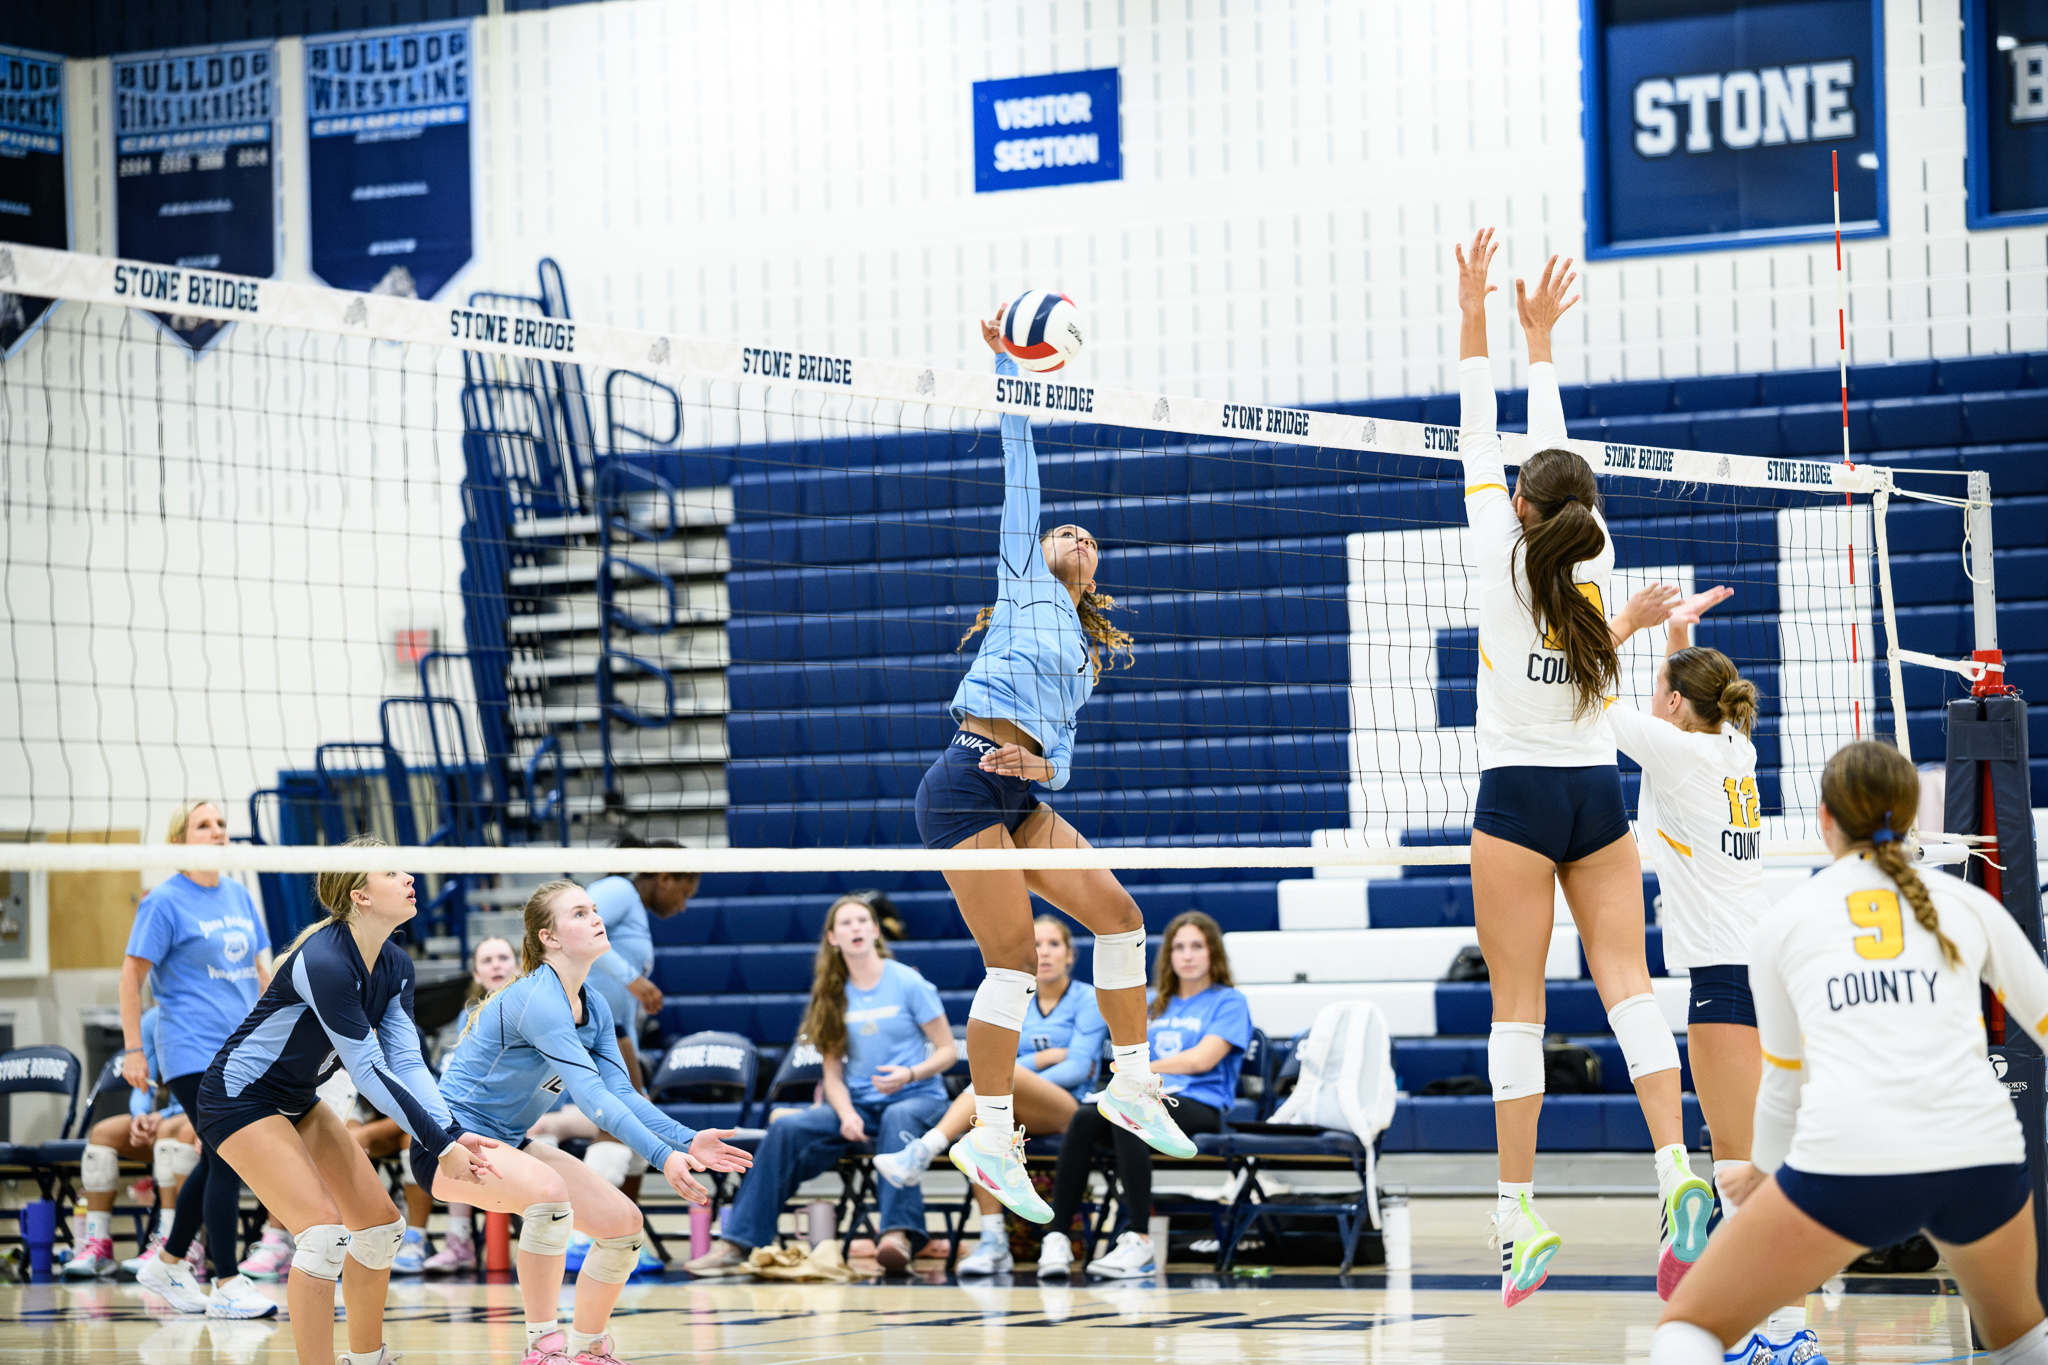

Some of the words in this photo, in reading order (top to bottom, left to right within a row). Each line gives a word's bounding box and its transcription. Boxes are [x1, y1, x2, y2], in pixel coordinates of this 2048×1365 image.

[119, 54, 268, 92] BULLDOG
[312, 34, 465, 73] BULLDOG
[993, 92, 1093, 131] VISITOR
[1634, 59, 1856, 157] STONE
[993, 132, 1100, 172] SECTION
[114, 264, 181, 302] STONE
[188, 274, 259, 313] BRIDGE
[450, 309, 507, 344] STONE
[513, 317, 576, 353] BRIDGE
[743, 347, 792, 379] STONE
[799, 354, 852, 386] BRIDGE
[996, 378, 1042, 408] STONE
[1046, 383, 1095, 413] BRIDGE
[1221, 404, 1264, 431] STONE
[1266, 408, 1310, 437] BRIDGE
[1423, 426, 1460, 452] STONE
[1604, 444, 1636, 469] STONE
[1638, 448, 1675, 473] BRIDGE
[1767, 460, 1798, 483] STONE
[1799, 462, 1833, 485] BRIDGE
[1722, 776, 1761, 828] 12
[1721, 829, 1761, 861] COUNT
[1846, 887, 1905, 961] 9
[1826, 970, 1938, 1013] COUNTY
[2001, 1081, 2028, 1091] PORTS
